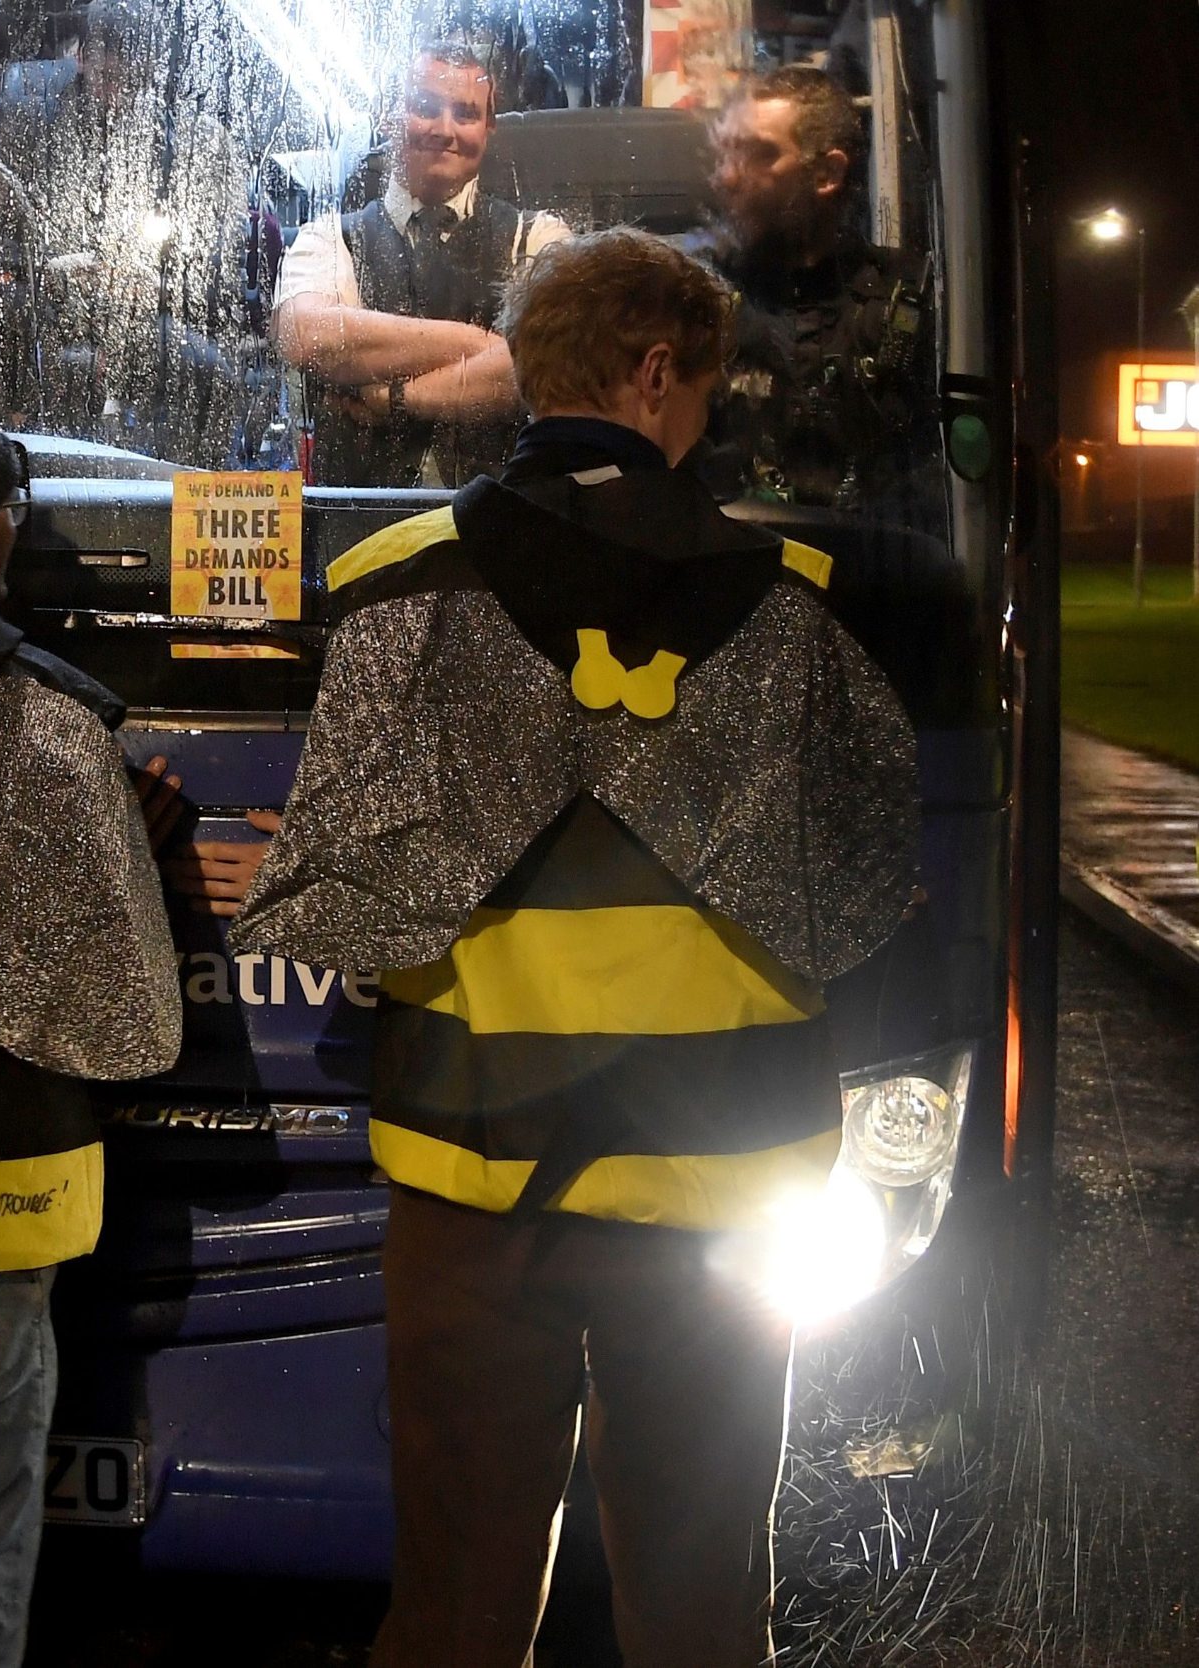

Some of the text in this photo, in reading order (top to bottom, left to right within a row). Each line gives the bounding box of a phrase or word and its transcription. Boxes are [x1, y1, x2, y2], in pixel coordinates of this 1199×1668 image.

[1135, 381, 1199, 431] J
[188, 483, 290, 498] WE DEMAND A
[194, 509, 281, 539] THREE
[185, 547, 290, 570] DEMANDS
[208, 575, 267, 606] BILL
[177, 951, 382, 1009] ative
[113, 1106, 350, 1136] URISMO
